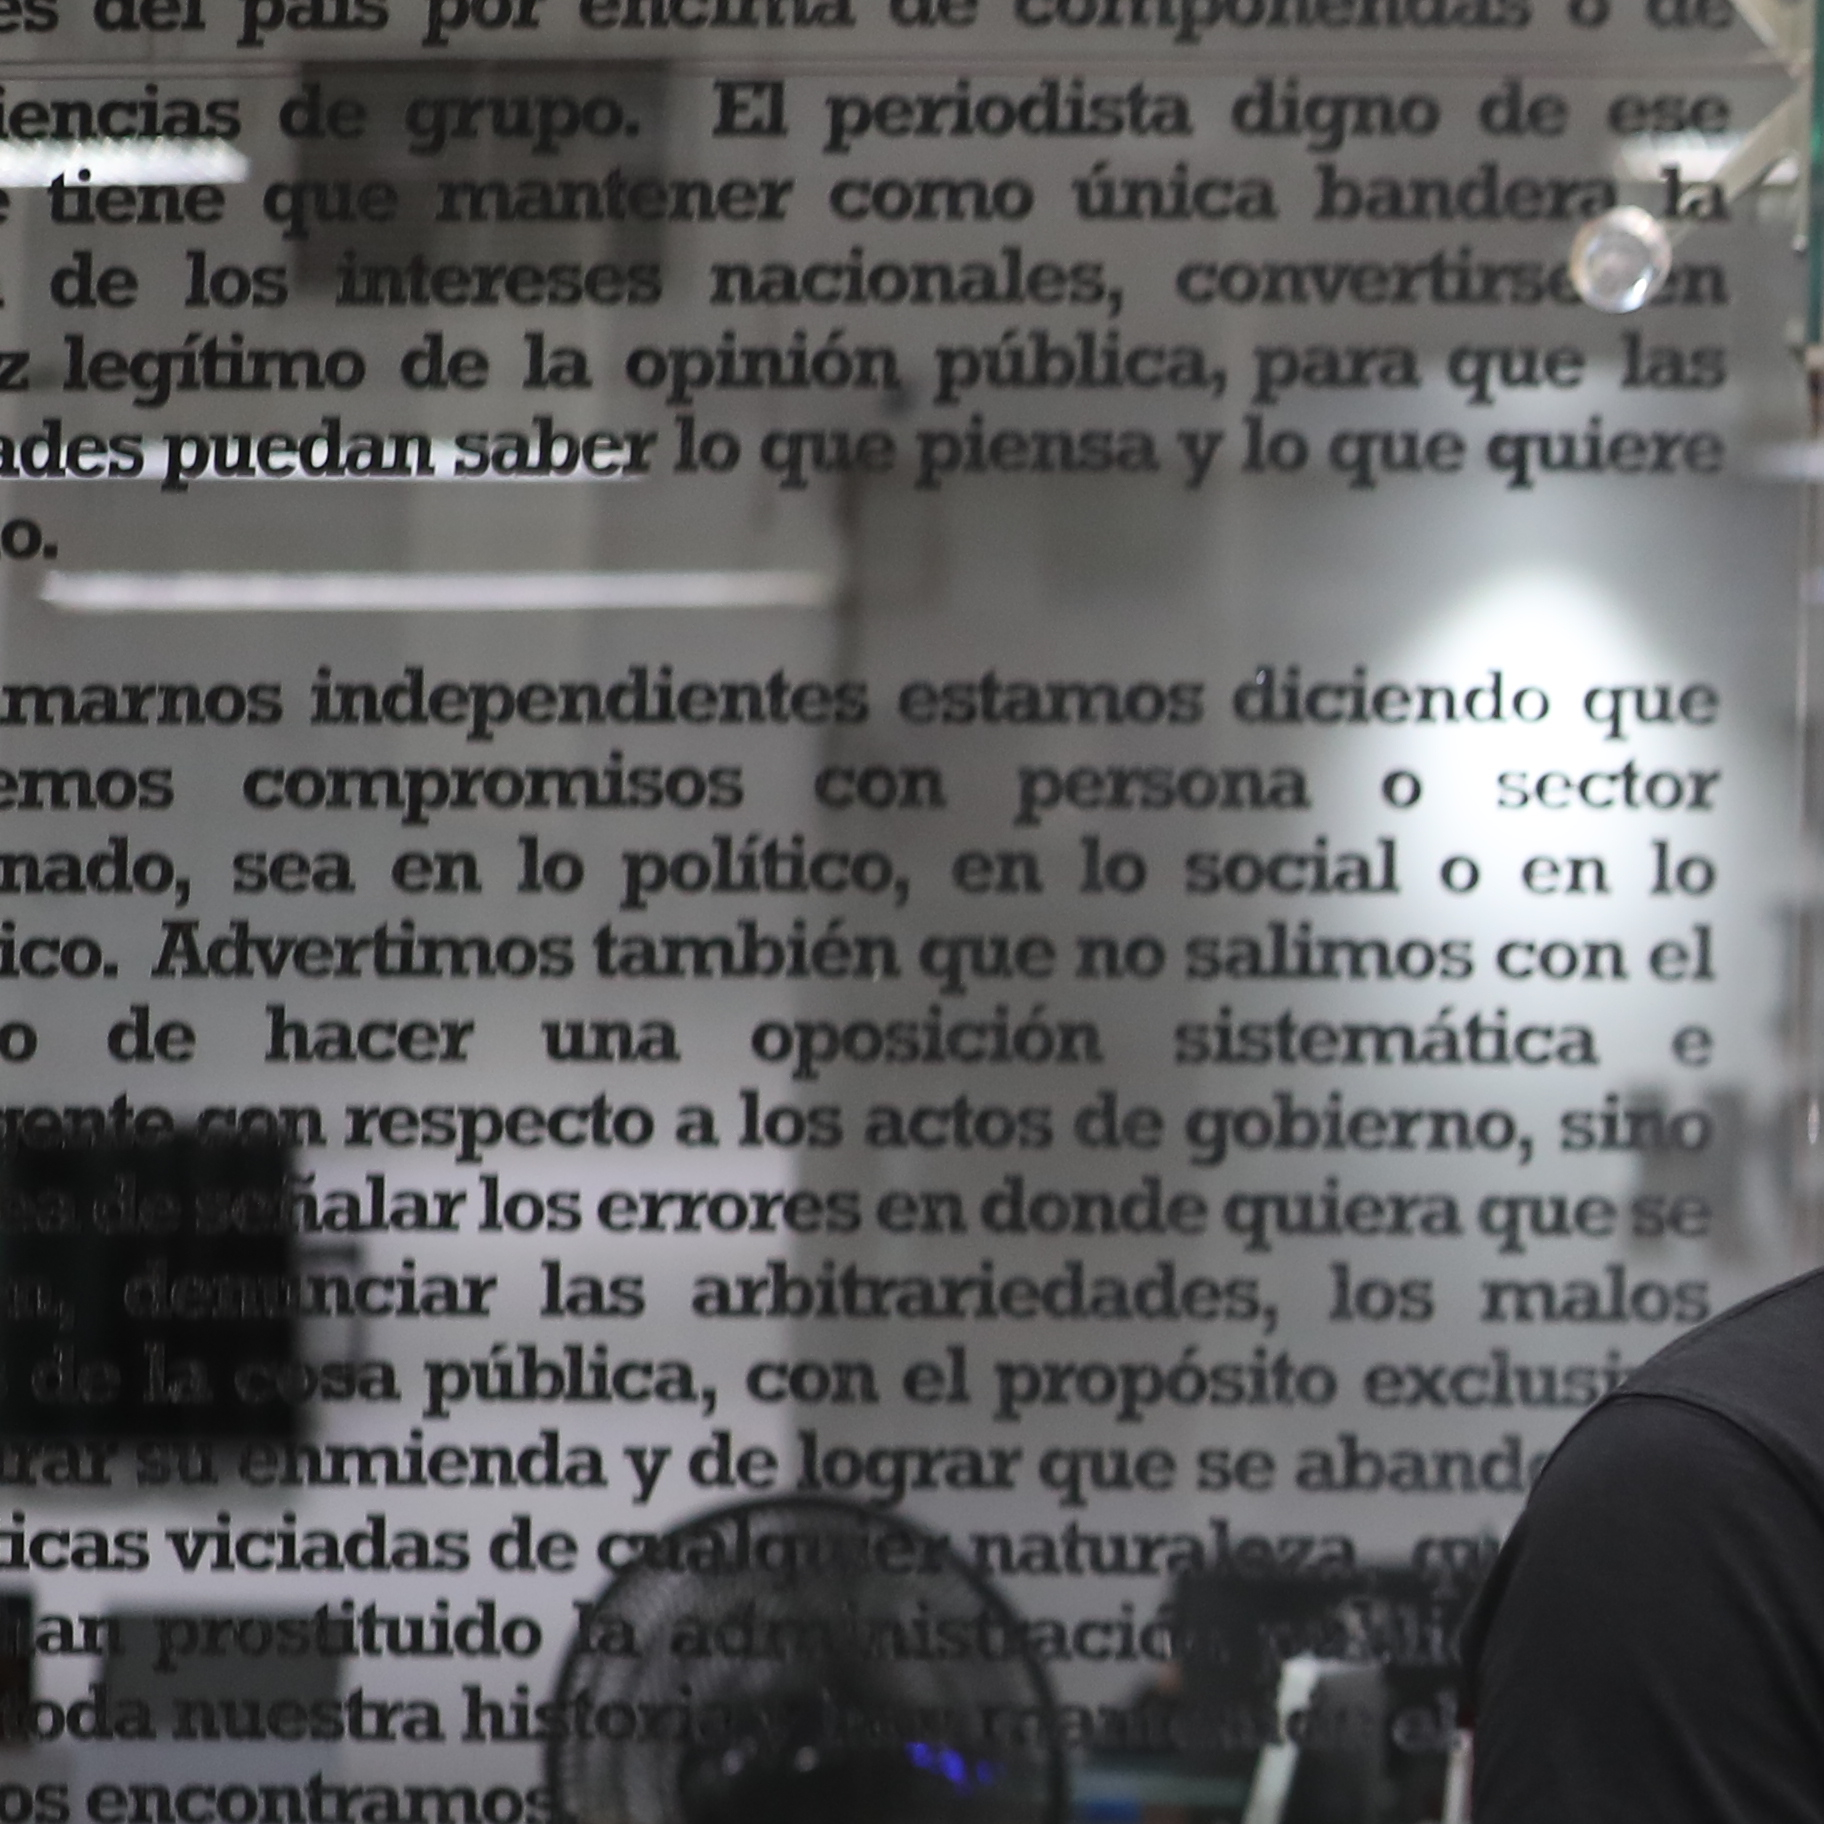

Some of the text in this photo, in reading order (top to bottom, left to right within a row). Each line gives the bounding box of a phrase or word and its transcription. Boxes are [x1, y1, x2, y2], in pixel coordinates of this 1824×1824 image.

[407, 78, 1440, 155] grupo. periodista digno
[47, 153, 1618, 224] tiene mantener como única bandera
[186, 246, 1122, 317] los intereses nacionales,
[63, 330, 1419, 408] legítimo opinión pública, para
[162, 405, 1721, 491] puedan saber piensa quiere
[312, 666, 868, 742] independientes
[899, 672, 1203, 724] estamos
[1233, 666, 1549, 724] diciendo
[244, 751, 1720, 826] compromisos persona sector
[233, 834, 1398, 911] sea político, social
[152, 919, 1473, 979] Advertimos también salimos
[266, 1004, 1598, 1081] hacer oposición sistemática
[346, 1092, 1711, 1167] respecto actos gobierno, sino
[480, 1175, 1615, 1254] los errores donde quiera que
[542, 1260, 1708, 1333] las arbitrariedades, los malos
[229, 1344, 1337, 1422] cosa pública, con propósito
[241, 1429, 1175, 1508] enmienda lograr que
[167, 1513, 1360, 1581] viciadas naturaleza
[157, 1599, 542, 1670] prostituido
[174, 1689, 445, 1742] nuestra
